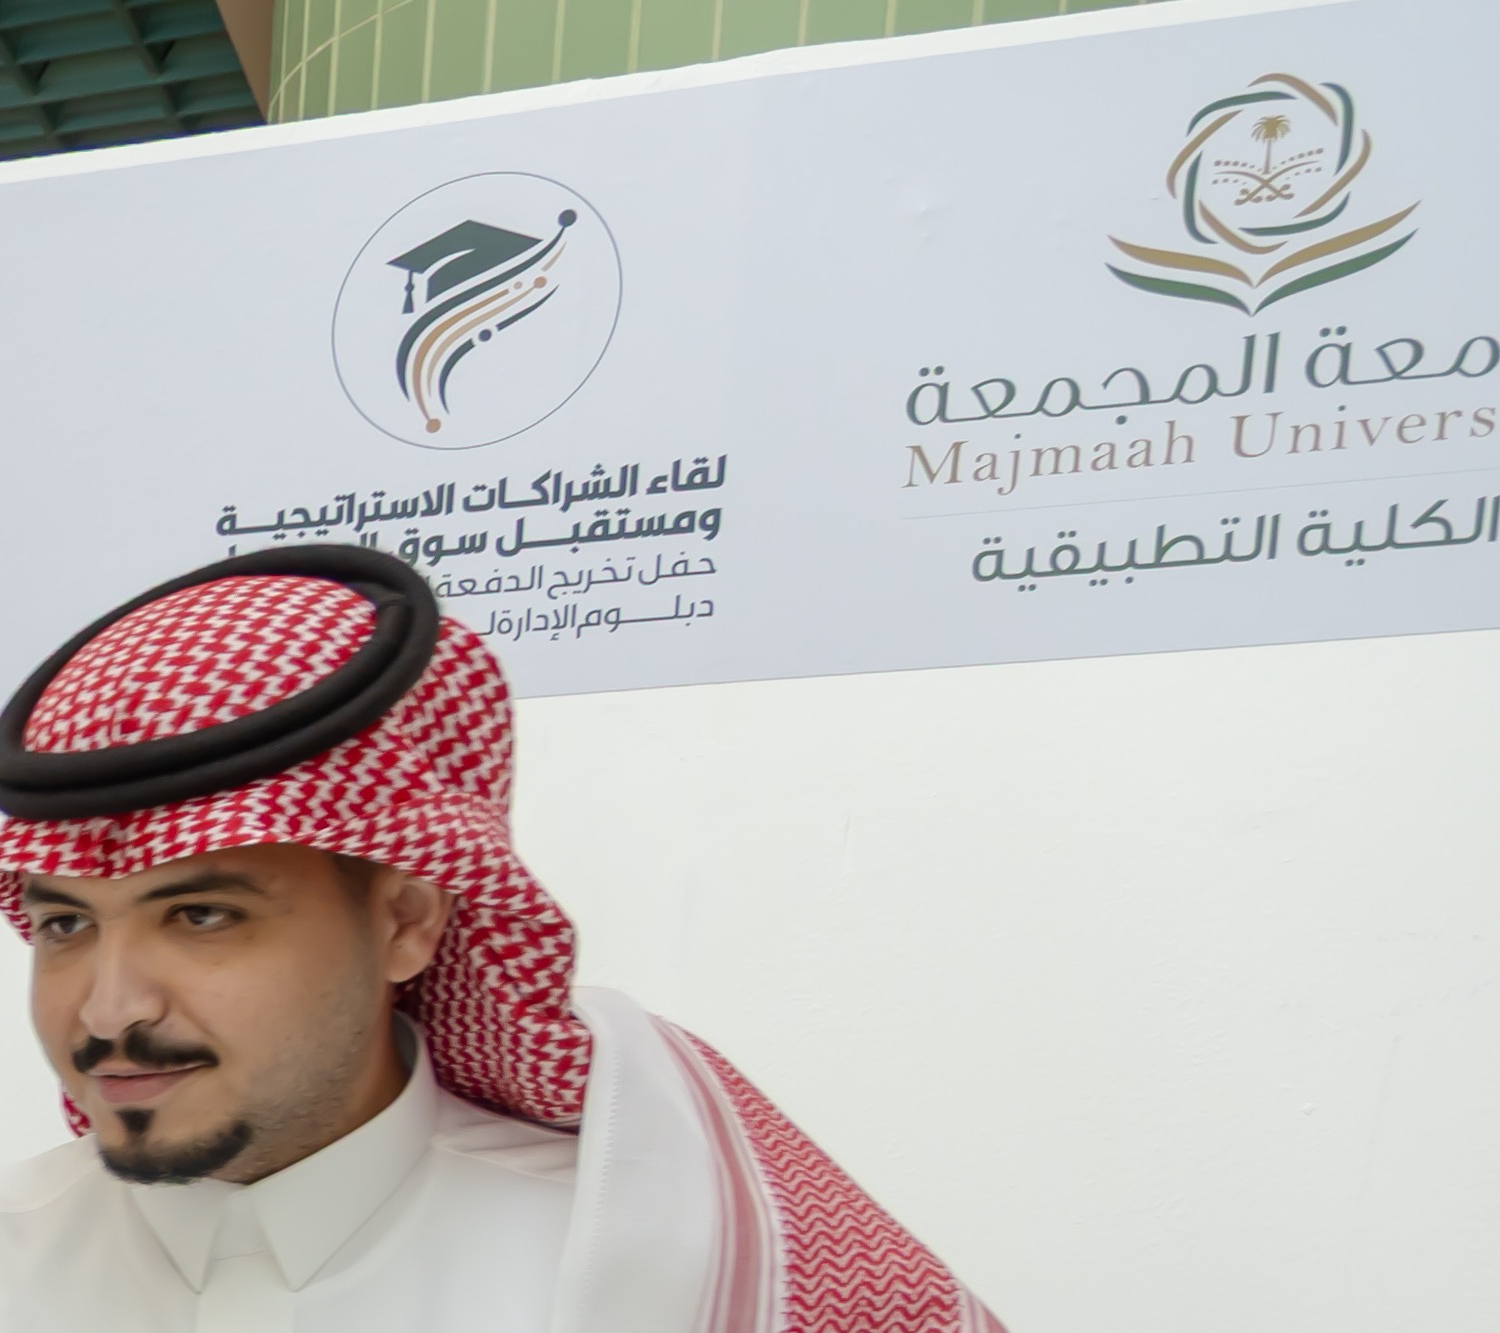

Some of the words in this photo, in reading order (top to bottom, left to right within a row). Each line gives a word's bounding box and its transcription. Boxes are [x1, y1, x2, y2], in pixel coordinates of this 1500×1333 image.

[905, 331, 1281, 425] المجمعة
[1305, 325, 1500, 389] معة
[645, 455, 727, 496] لقاء
[902, 419, 1196, 496] Majmaah
[1230, 404, 1497, 459] Univers
[215, 483, 455, 540] الاستراتيجية
[462, 463, 640, 513] الشراكات
[495, 505, 722, 557] ومستقبل
[972, 513, 1281, 592] التطبيقية
[1297, 495, 1500, 567] الكلية
[436, 566, 543, 598] الدفعة
[546, 556, 634, 598] تخريج
[637, 552, 716, 585] حفل
[498, 608, 576, 641] الإدارة
[576, 595, 714, 636] دبلوم
